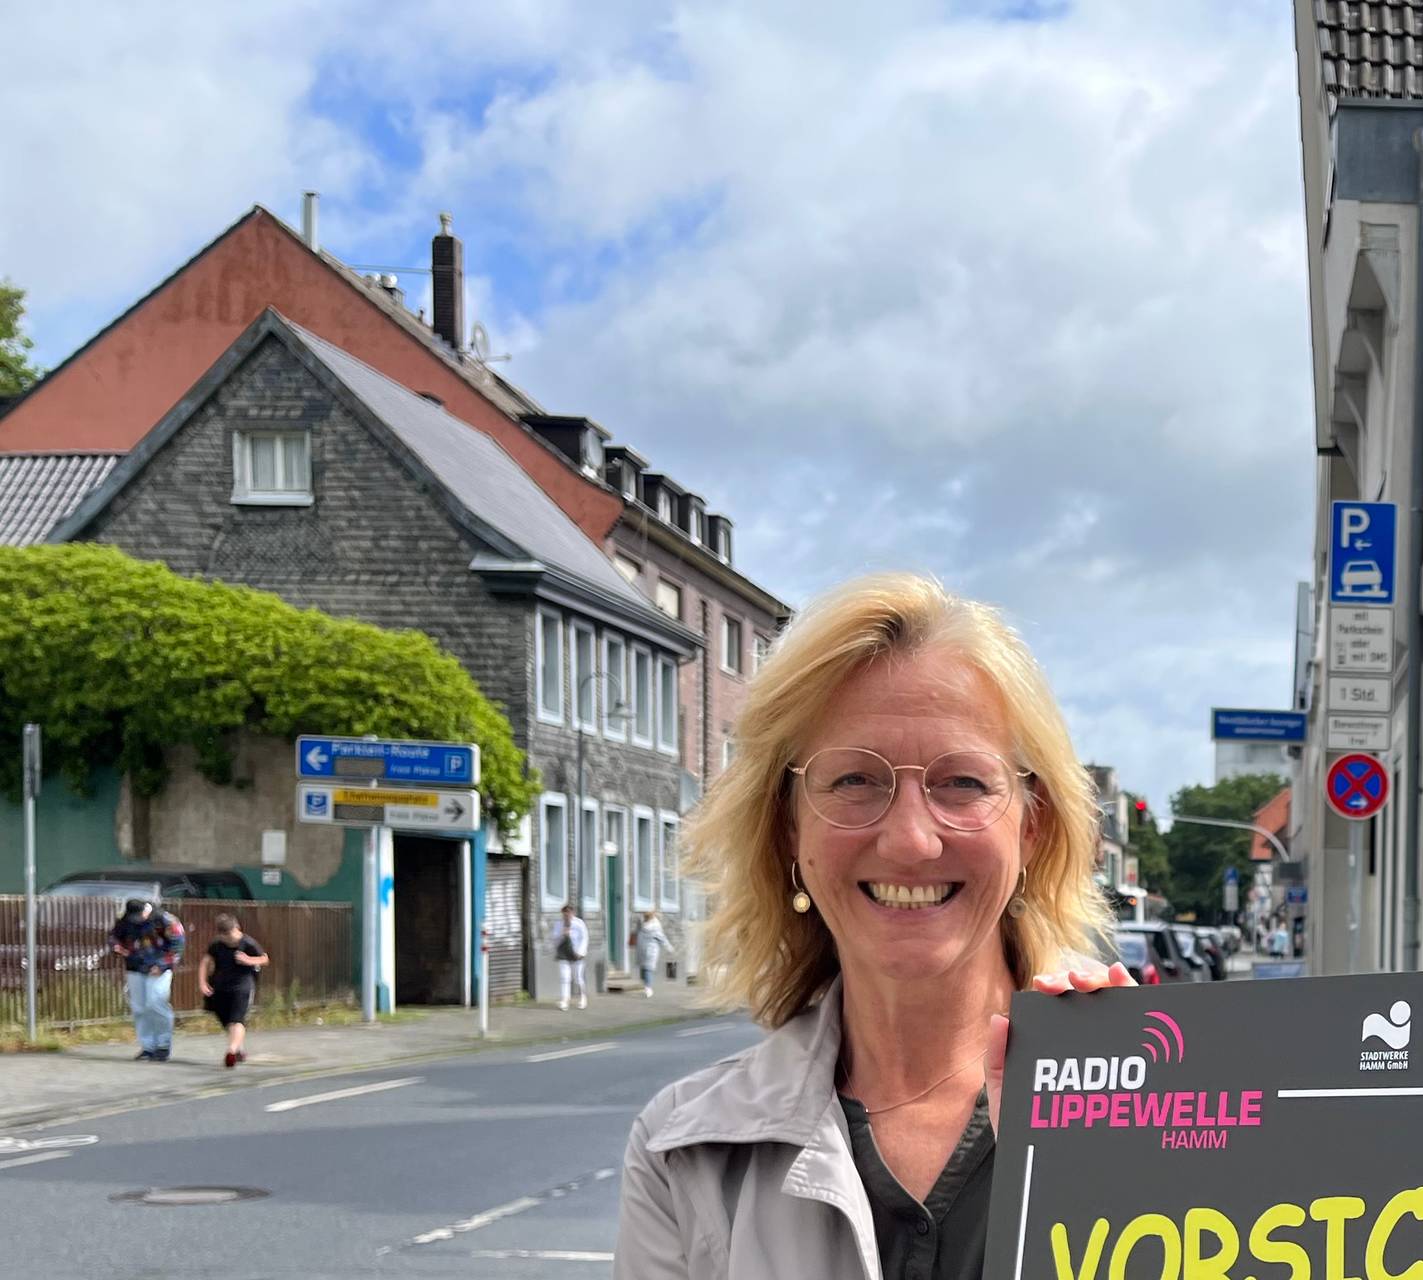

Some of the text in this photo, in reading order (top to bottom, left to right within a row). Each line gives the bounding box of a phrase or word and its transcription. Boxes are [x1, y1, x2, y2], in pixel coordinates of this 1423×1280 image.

[1340, 508, 1370, 548] P
[1360, 1051, 1409, 1061] STADTWERKE
[1360, 1061, 1409, 1070] HAMM GmbH
[1033, 1056, 1147, 1092] RADIO
[1030, 1090, 1262, 1128] LIPPEWELLE
[1161, 1129, 1228, 1150] HAMM
